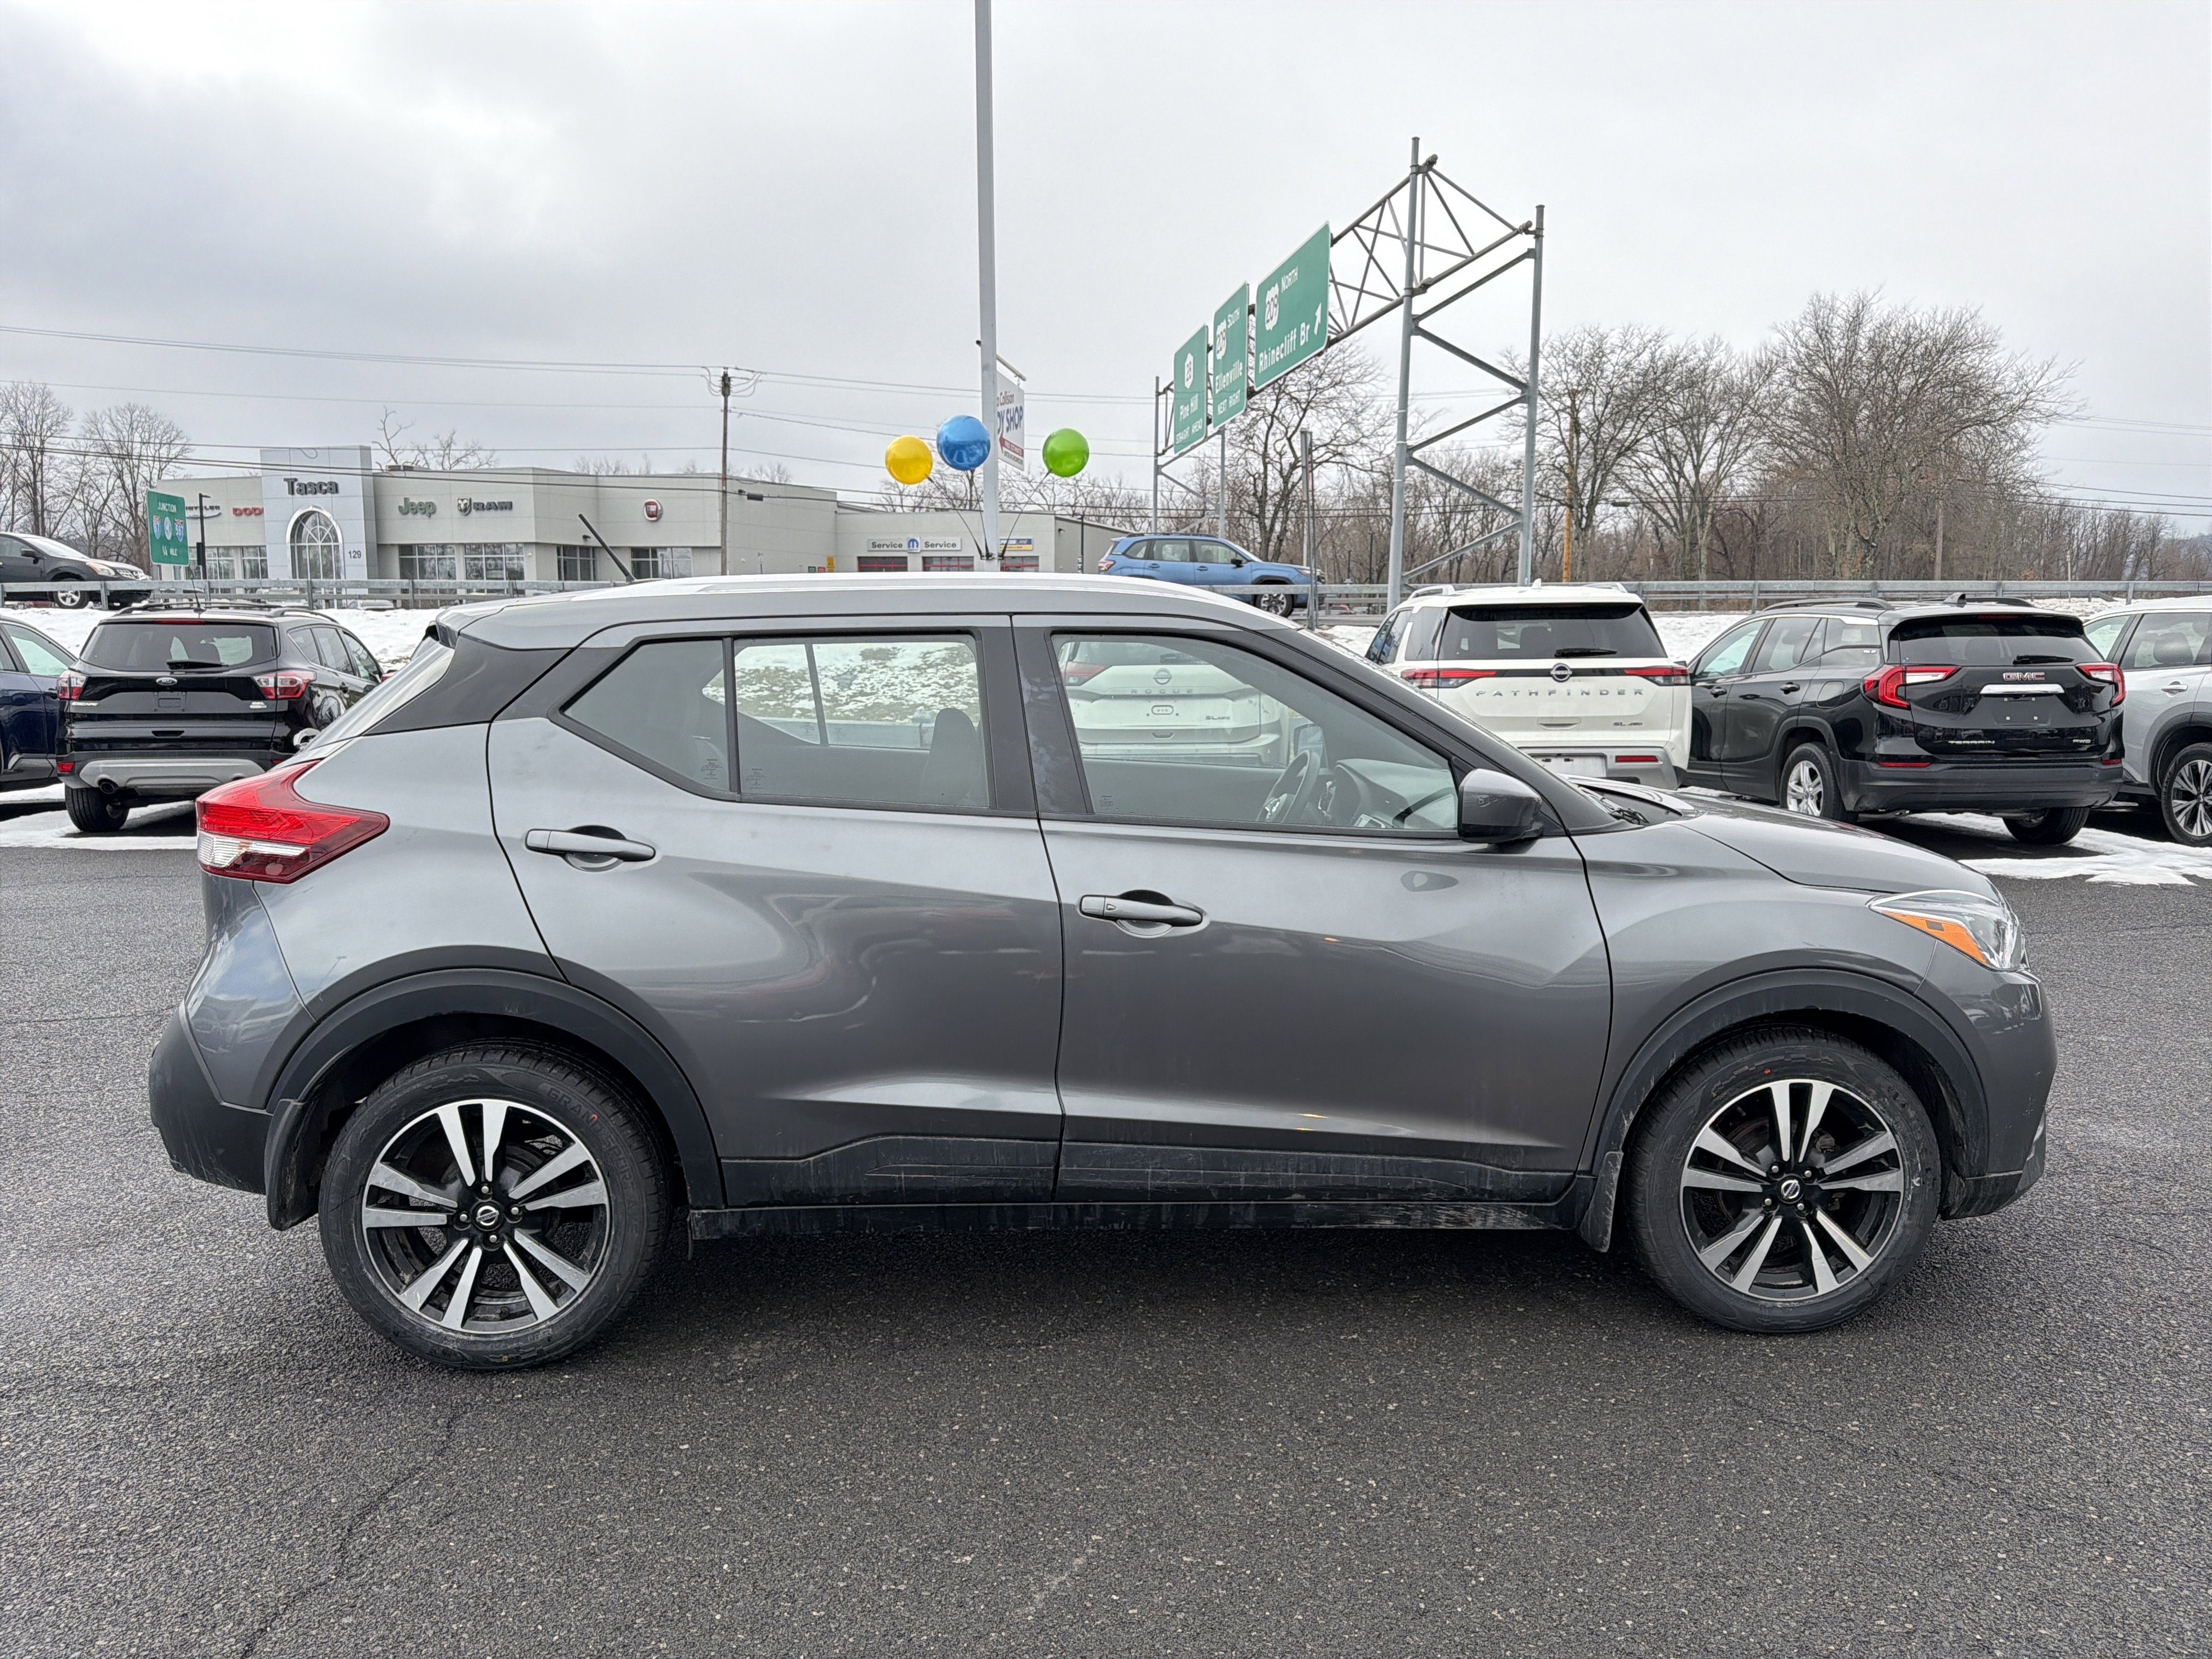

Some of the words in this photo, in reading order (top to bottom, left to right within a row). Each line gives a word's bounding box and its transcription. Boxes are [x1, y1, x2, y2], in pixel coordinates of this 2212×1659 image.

[1266, 294, 1278, 324] 209
[1282, 267, 1299, 292] NORTH
[1217, 328, 1226, 354] 209
[1259, 328, 1297, 374] Rhinecliff
[1300, 322, 1310, 346] Br
[1215, 359, 1243, 394] Ellenville
[1000, 390, 1014, 406] Collision
[1180, 404, 1189, 422] Pine
[1190, 393, 1199, 414] Hill
[1229, 389, 1241, 408] RIGHT
[1006, 405, 1024, 433] SHOP
[284, 477, 339, 496] Tasca
[157, 501, 177, 513] JUNCTION
[398, 496, 437, 518] Jeep
[473, 501, 513, 511] RAM
[348, 550, 362, 559] 129
[2002, 672, 2045, 681] GMC
[1475, 689, 1643, 697] PATHFINDER
